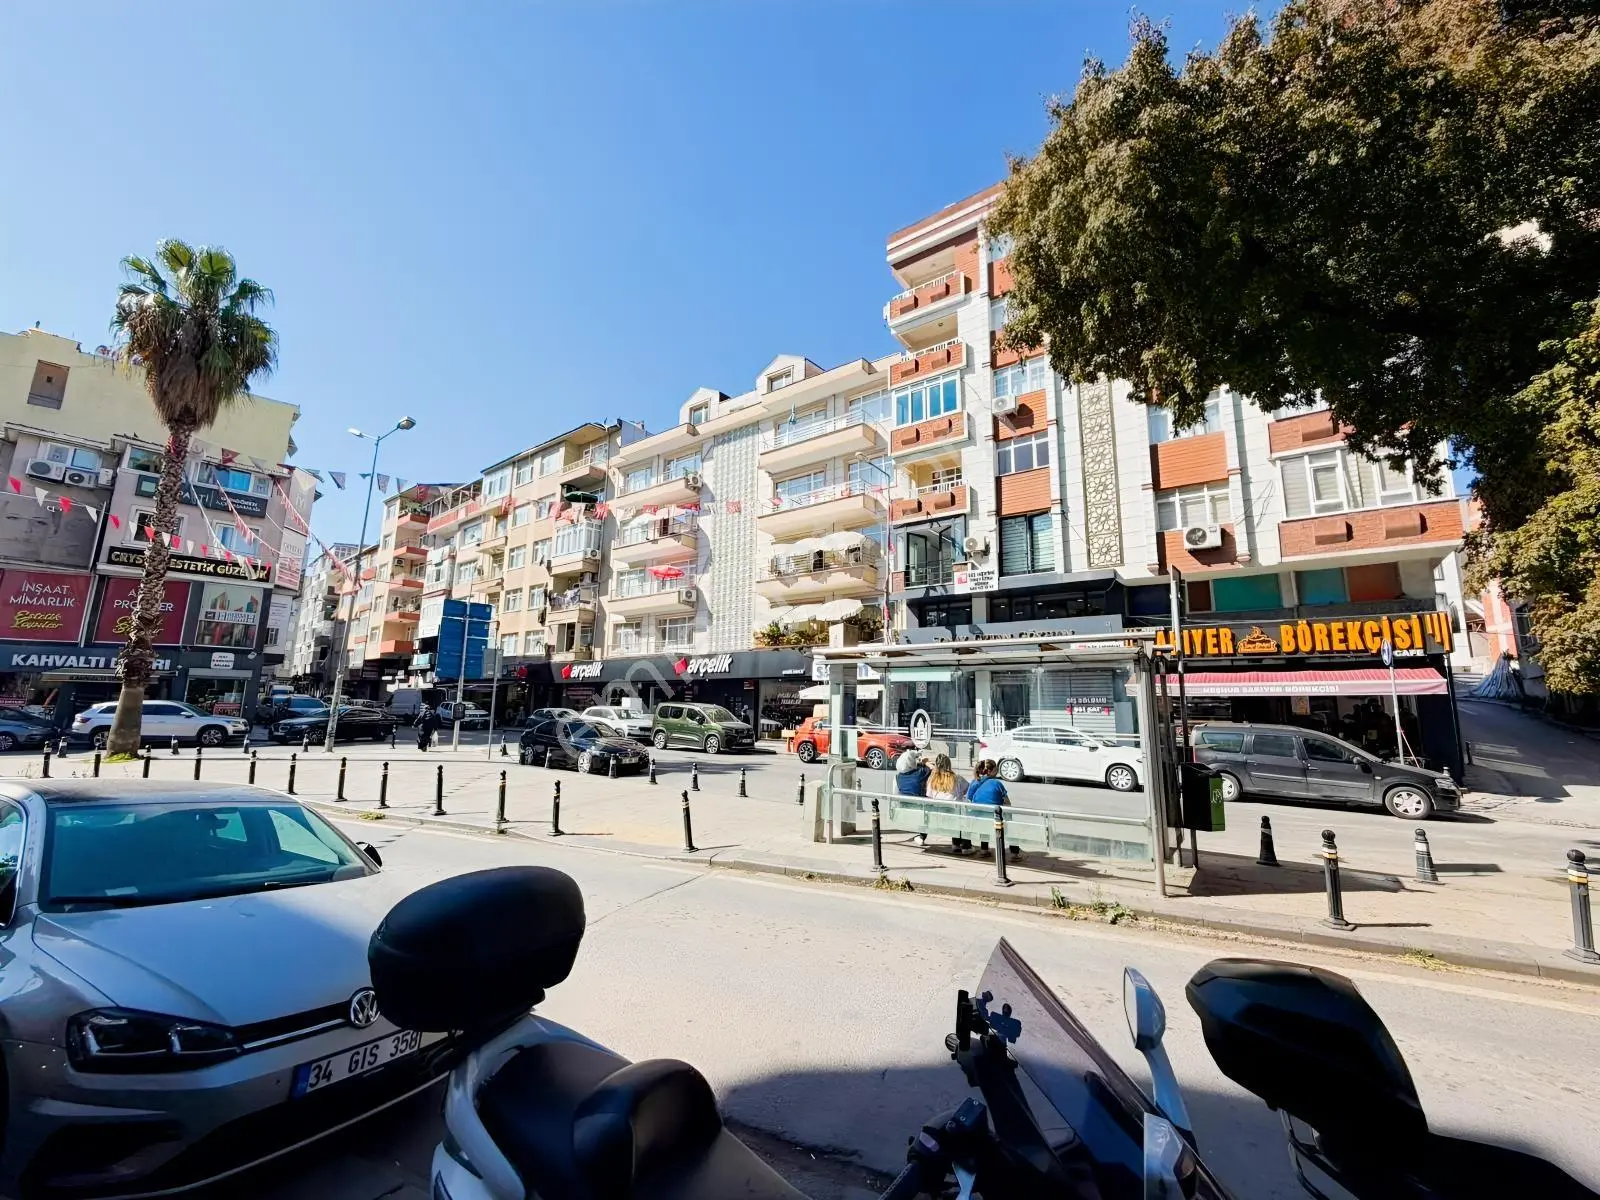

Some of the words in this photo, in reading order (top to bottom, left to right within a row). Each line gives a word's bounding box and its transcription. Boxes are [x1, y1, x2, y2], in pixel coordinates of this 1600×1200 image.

[111, 551, 145, 565] CRYS
[22, 580, 71, 595] İNŞAAT
[9, 592, 76, 607] MİMARLIK
[113, 599, 174, 612] PROER
[1280, 614, 1424, 654] BÖREKÇİSİ
[11, 653, 106, 668] KAHVALTI
[687, 653, 733, 678] arçelik
[570, 661, 603, 681] arçelik
[308, 1059, 333, 1088] 34
[348, 1044, 380, 1074] GIS
[390, 1029, 418, 1058] 358
